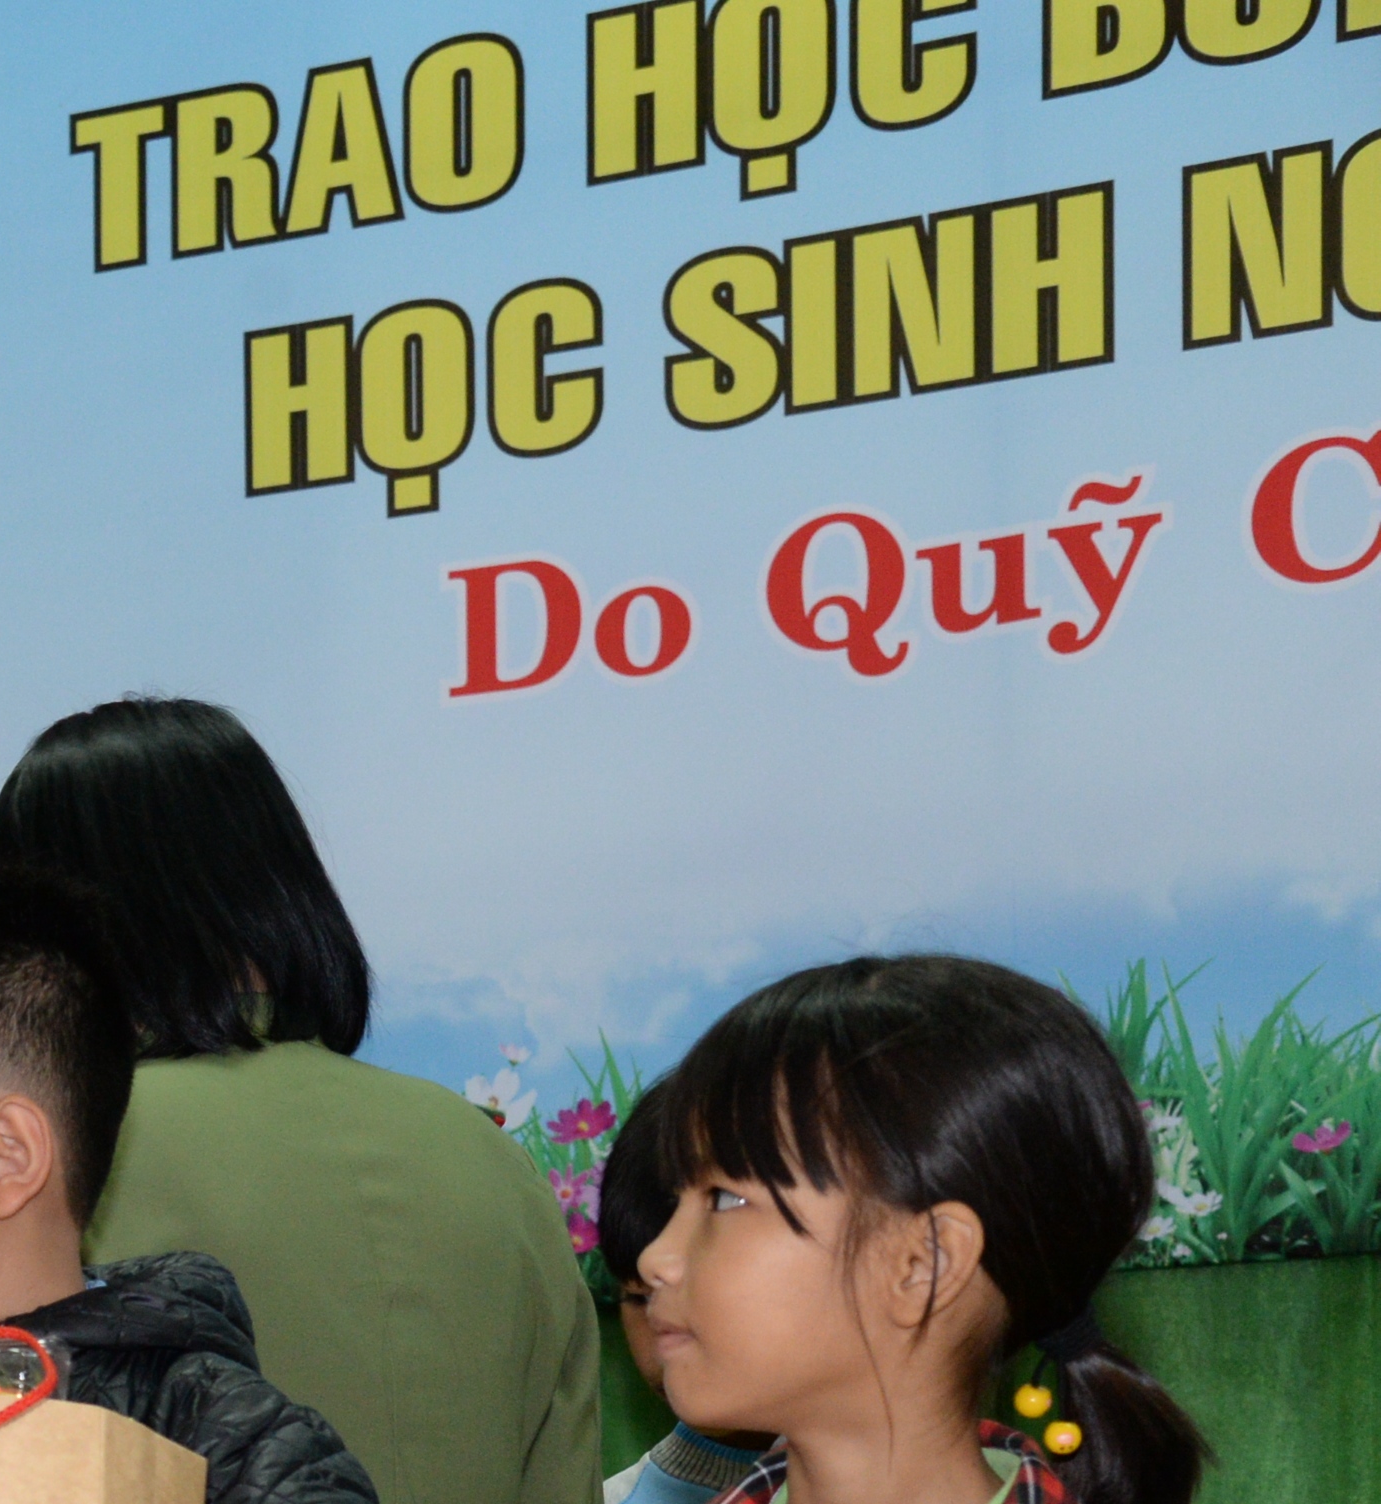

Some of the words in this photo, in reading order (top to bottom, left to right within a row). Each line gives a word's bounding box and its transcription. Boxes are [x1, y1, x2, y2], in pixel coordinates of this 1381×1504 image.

[69, 32, 525, 273] TRAO
[585, 0, 977, 201] HỌC
[243, 276, 604, 519] HỌC
[662, 180, 1115, 432] SINH
[448, 558, 693, 698] Do
[765, 474, 1163, 680] Quỹ
